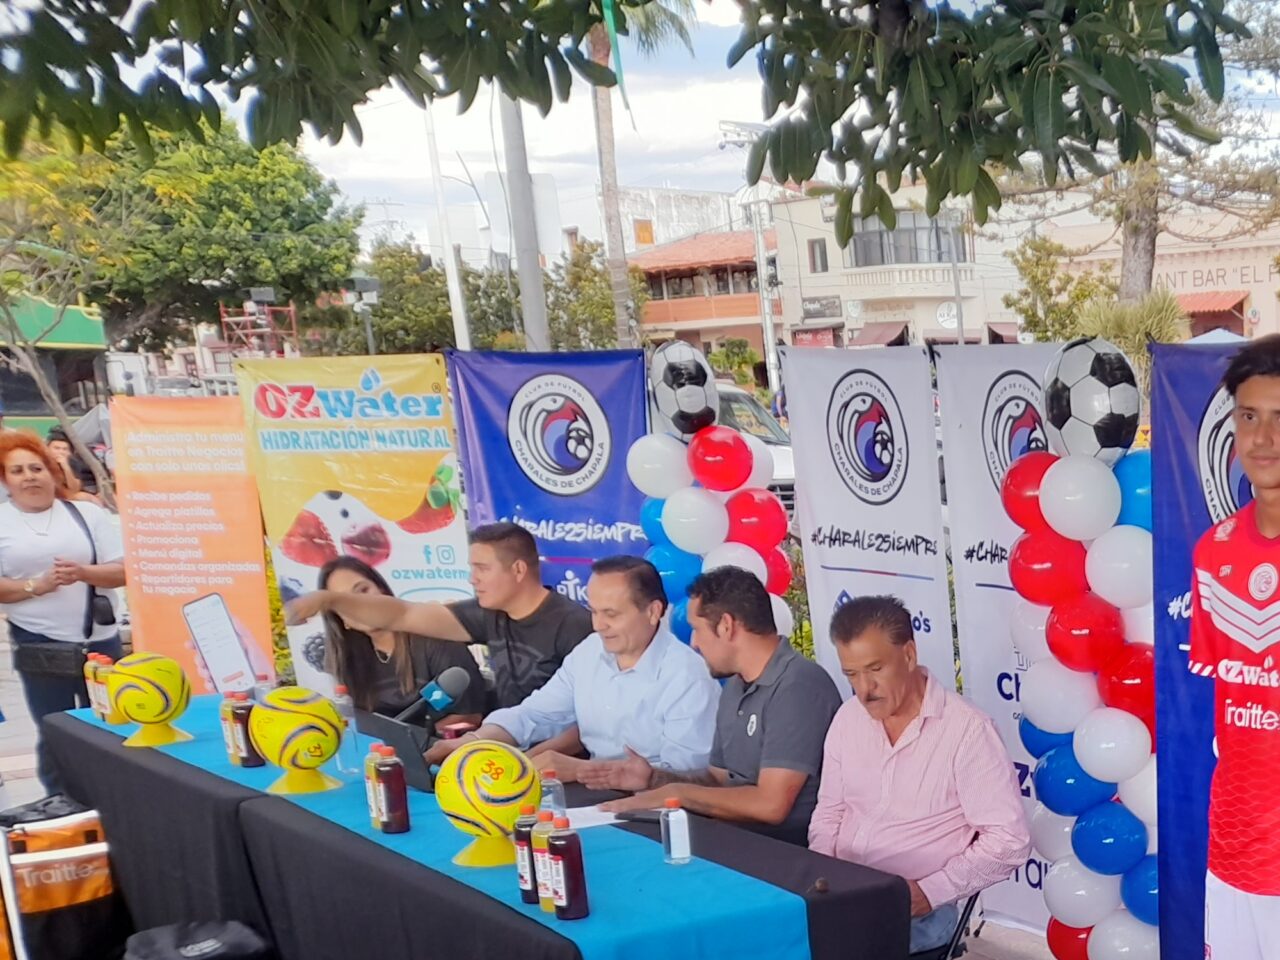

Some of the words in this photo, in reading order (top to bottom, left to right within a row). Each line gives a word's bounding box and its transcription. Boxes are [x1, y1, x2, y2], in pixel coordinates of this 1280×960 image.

[1192, 268, 1227, 288] BAR
[374, 428, 450, 449] NATURAL
[514, 439, 559, 488] CHARALES
[560, 479, 575, 489] DE
[575, 441, 606, 486] CHAPALA
[833, 442, 871, 495] CHARALES
[870, 487, 883, 496] DE
[882, 446, 904, 494] CHAPALA
[480, 759, 505, 781] 38
